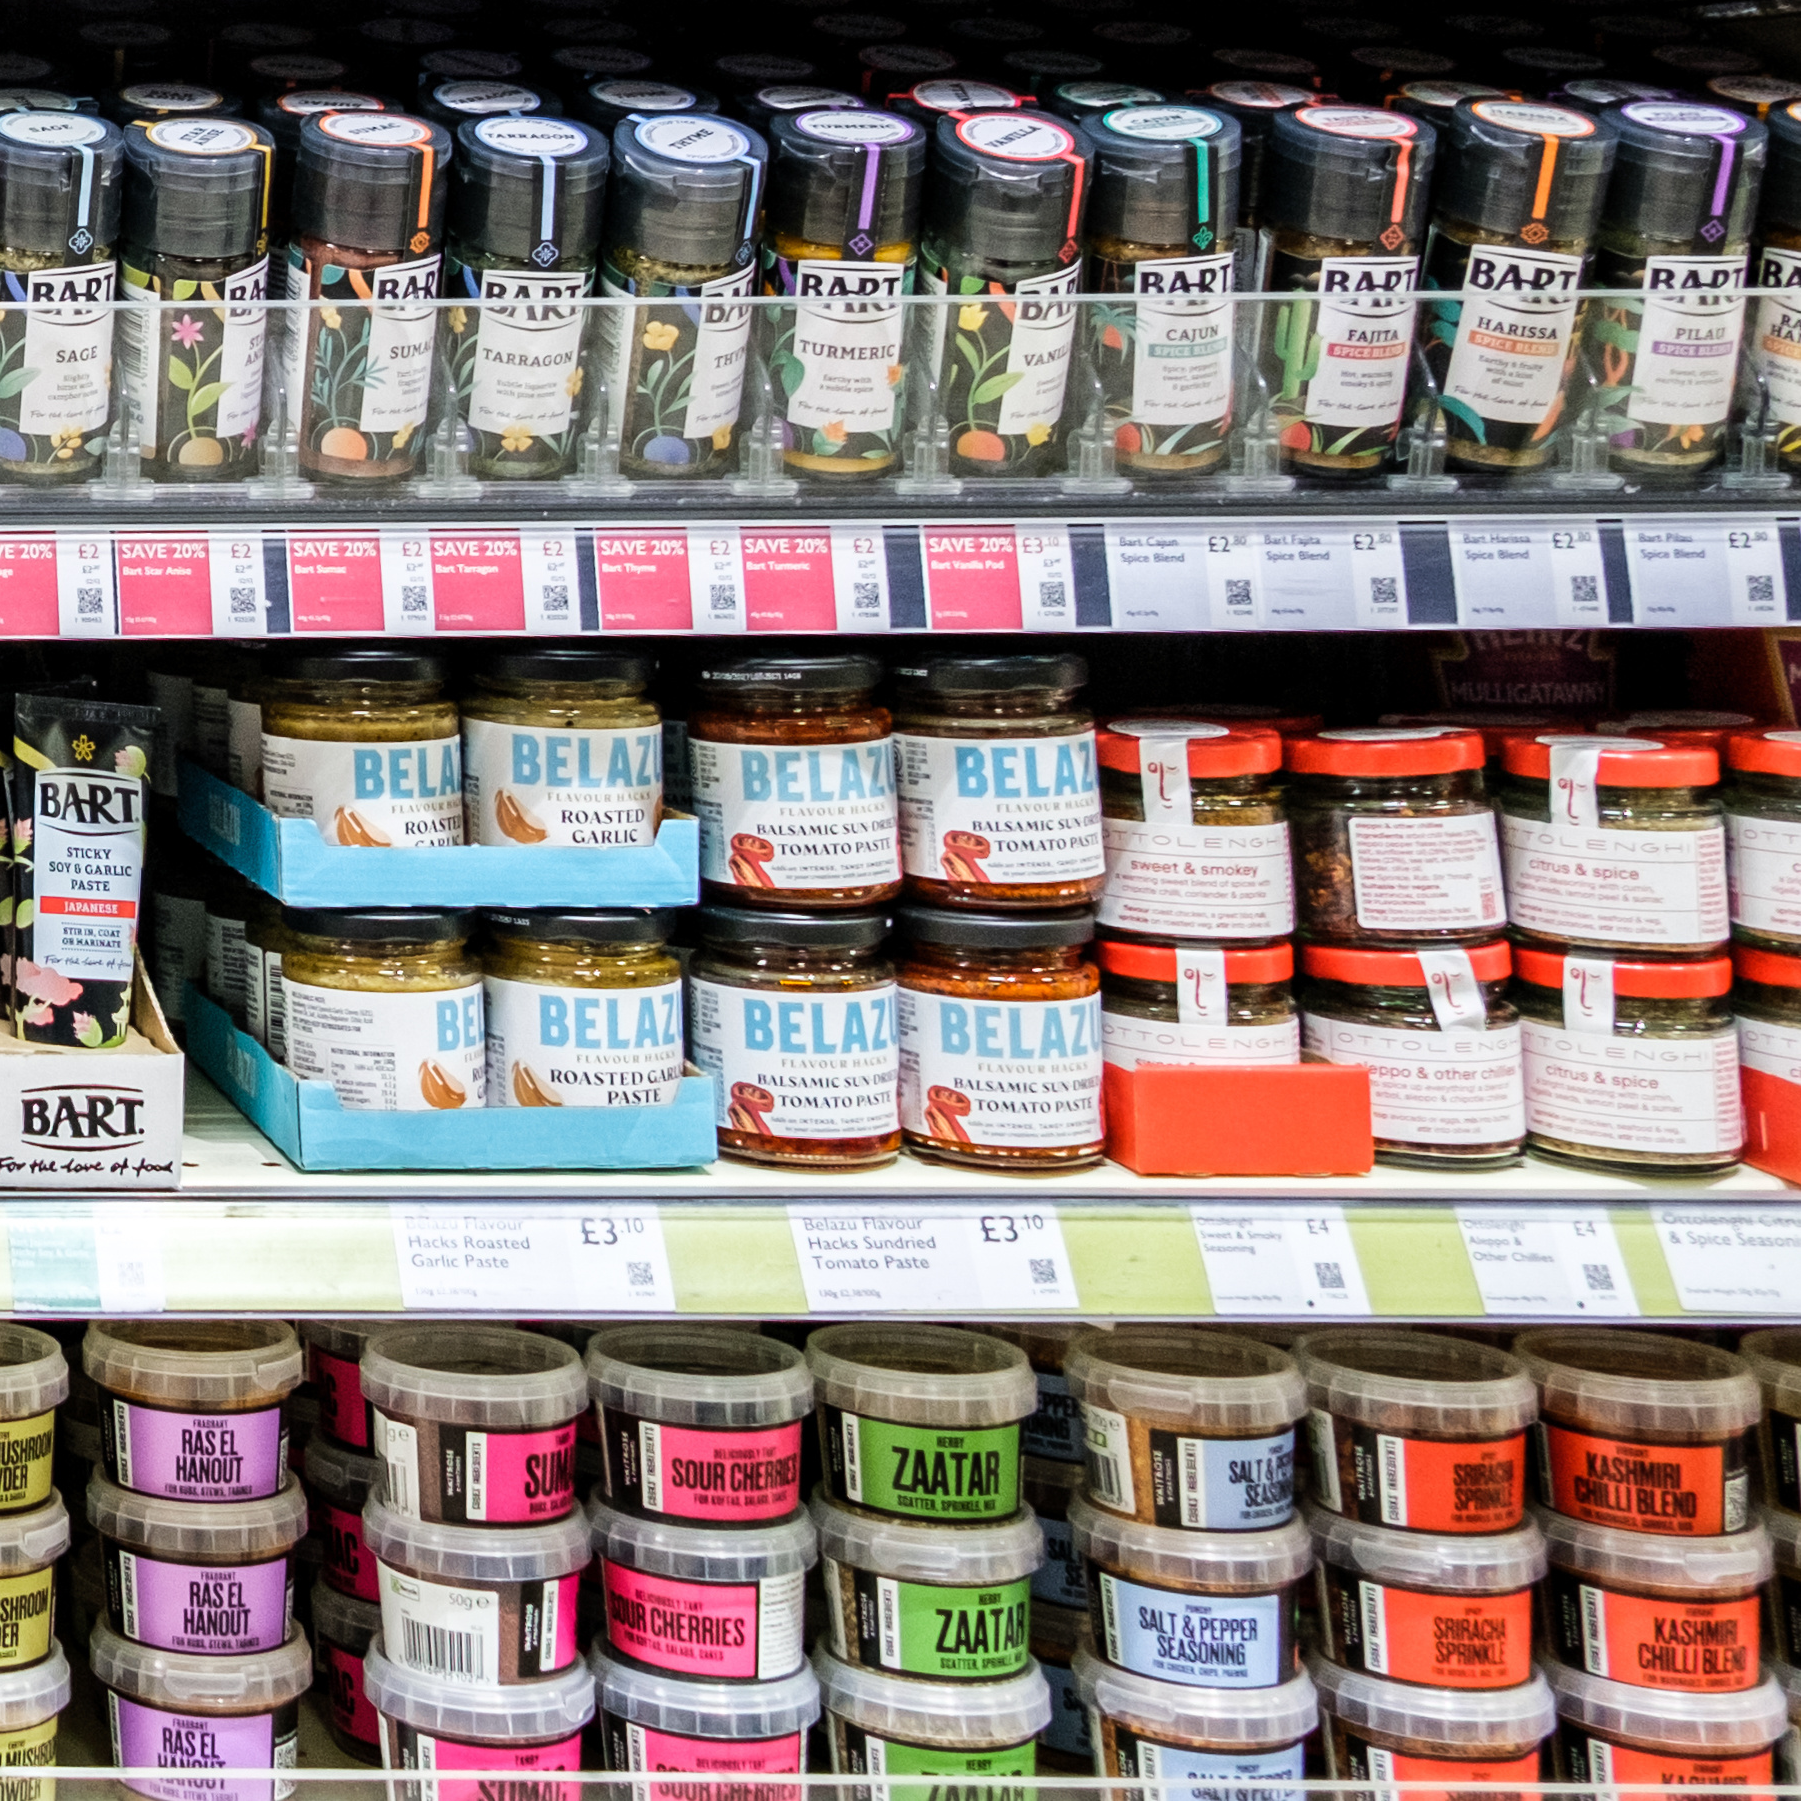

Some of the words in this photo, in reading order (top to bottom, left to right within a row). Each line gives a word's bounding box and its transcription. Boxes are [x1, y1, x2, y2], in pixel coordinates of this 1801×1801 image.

[1478, 317, 1557, 339] HARISSA
[56, 346, 97, 362] SAGE
[483, 349, 572, 366] TARRAGON
[799, 340, 894, 360] TURMERIC
[561, 810, 644, 826] ROASTED
[181, 1430, 214, 1457] RAS
[219, 1430, 236, 1456] EL
[176, 1456, 242, 1484] HANOUT
[893, 1444, 998, 1497] ZAATAR
[1140, 1607, 1178, 1633] SALT
[1181, 1616, 1196, 1638] &
[1200, 1616, 1258, 1643] PEPPER
[1157, 1637, 1245, 1667] SEASONING
